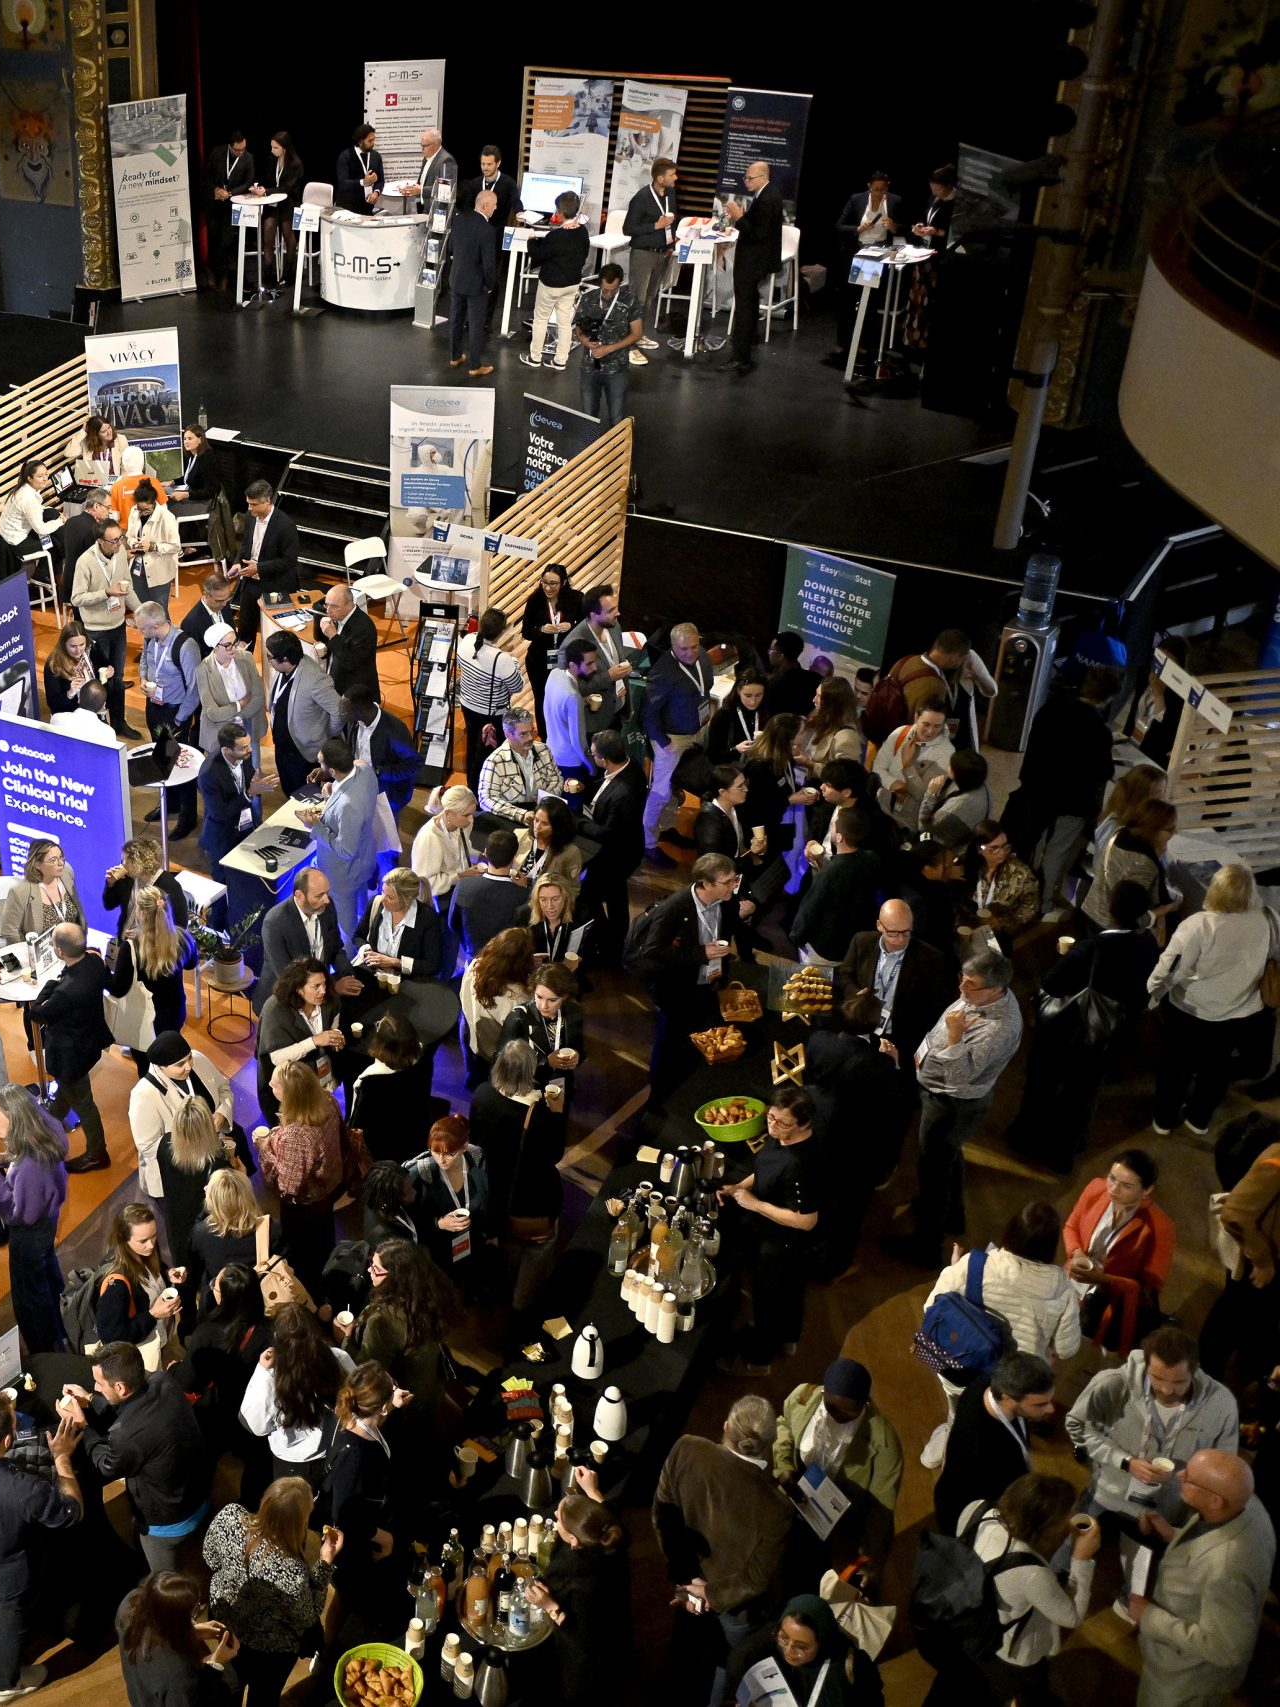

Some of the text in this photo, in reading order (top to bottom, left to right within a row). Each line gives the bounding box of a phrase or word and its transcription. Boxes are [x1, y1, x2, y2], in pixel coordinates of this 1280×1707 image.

[122, 170, 160, 182] Ready for
[145, 174, 180, 186] mindset?
[110, 349, 156, 363] VIVACY
[430, 398, 460, 406] devea
[534, 414, 563, 430] devea
[529, 432, 554, 450] Votre
[526, 457, 552, 473] notre
[528, 446, 568, 466] exigence
[804, 579, 868, 606] DONNEZ DES
[797, 589, 871, 619] AILES À VOTRE
[803, 602, 863, 628] RECHERCHE
[806, 614, 853, 635] CLINIQUE
[12, 634, 20, 644] for
[9, 644, 24, 657] trials
[1, 761, 95, 796] Join the New
[2, 777, 88, 812] Clinical Trial
[4, 794, 87, 828] Experience.
